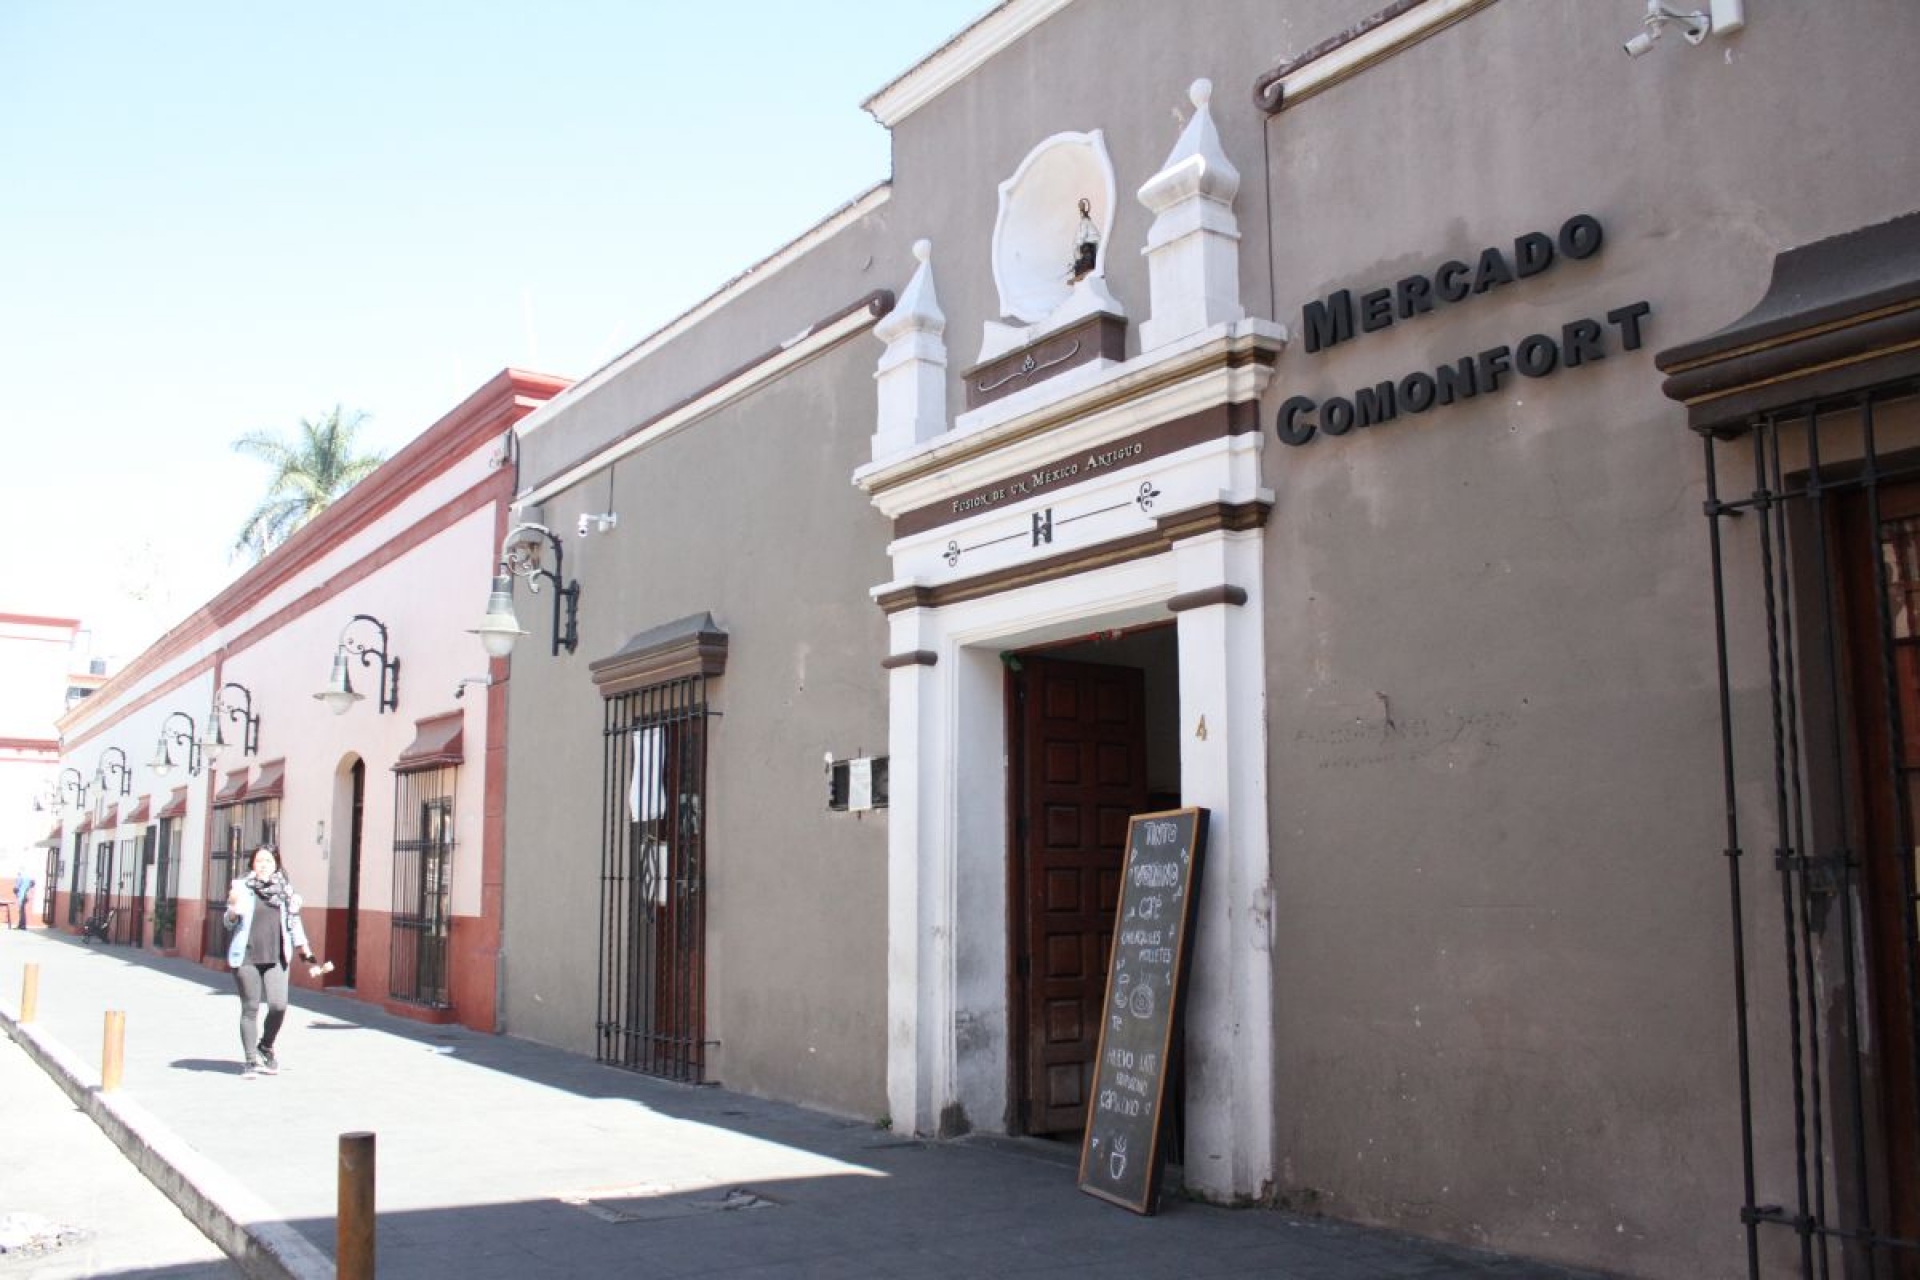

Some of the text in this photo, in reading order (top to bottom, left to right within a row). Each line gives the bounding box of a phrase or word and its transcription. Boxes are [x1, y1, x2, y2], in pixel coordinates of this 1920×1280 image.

[1303, 214, 1603, 352] MERCADO
[1276, 301, 1650, 446] COMONFORT
[993, 489, 1006, 501] DE
[1085, 443, 1143, 471] ANTIGUO
